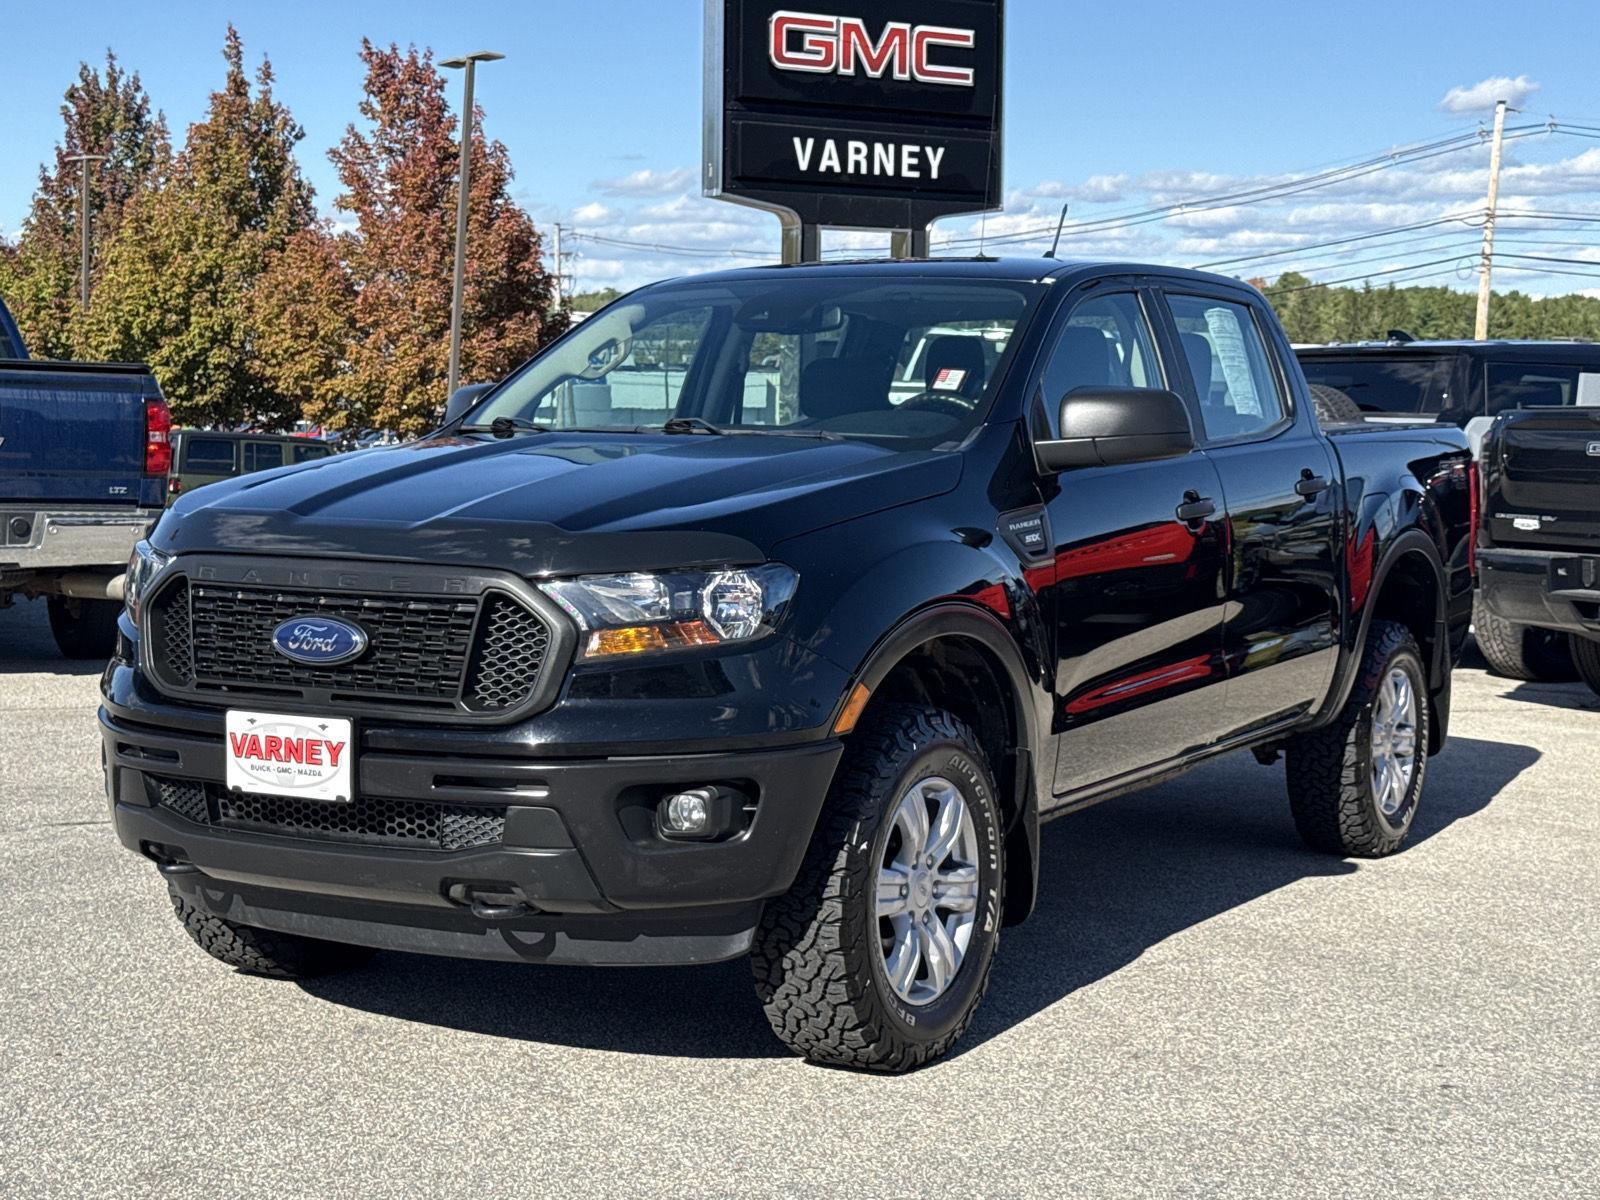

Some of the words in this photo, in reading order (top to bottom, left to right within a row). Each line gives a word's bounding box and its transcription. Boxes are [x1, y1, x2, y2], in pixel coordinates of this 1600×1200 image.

[768, 10, 976, 87] GMC
[793, 136, 945, 180] VARNEY
[109, 486, 128, 495] LTZ
[198, 566, 468, 593] RANGER
[288, 624, 339, 652] Ford
[229, 731, 346, 768] VARNEY
[250, 764, 272, 773] BUICK
[276, 766, 293, 775] GMC
[297, 769, 323, 777] MAZDA
[949, 755, 998, 870] All-Terrain
[983, 886, 998, 932] T/A
